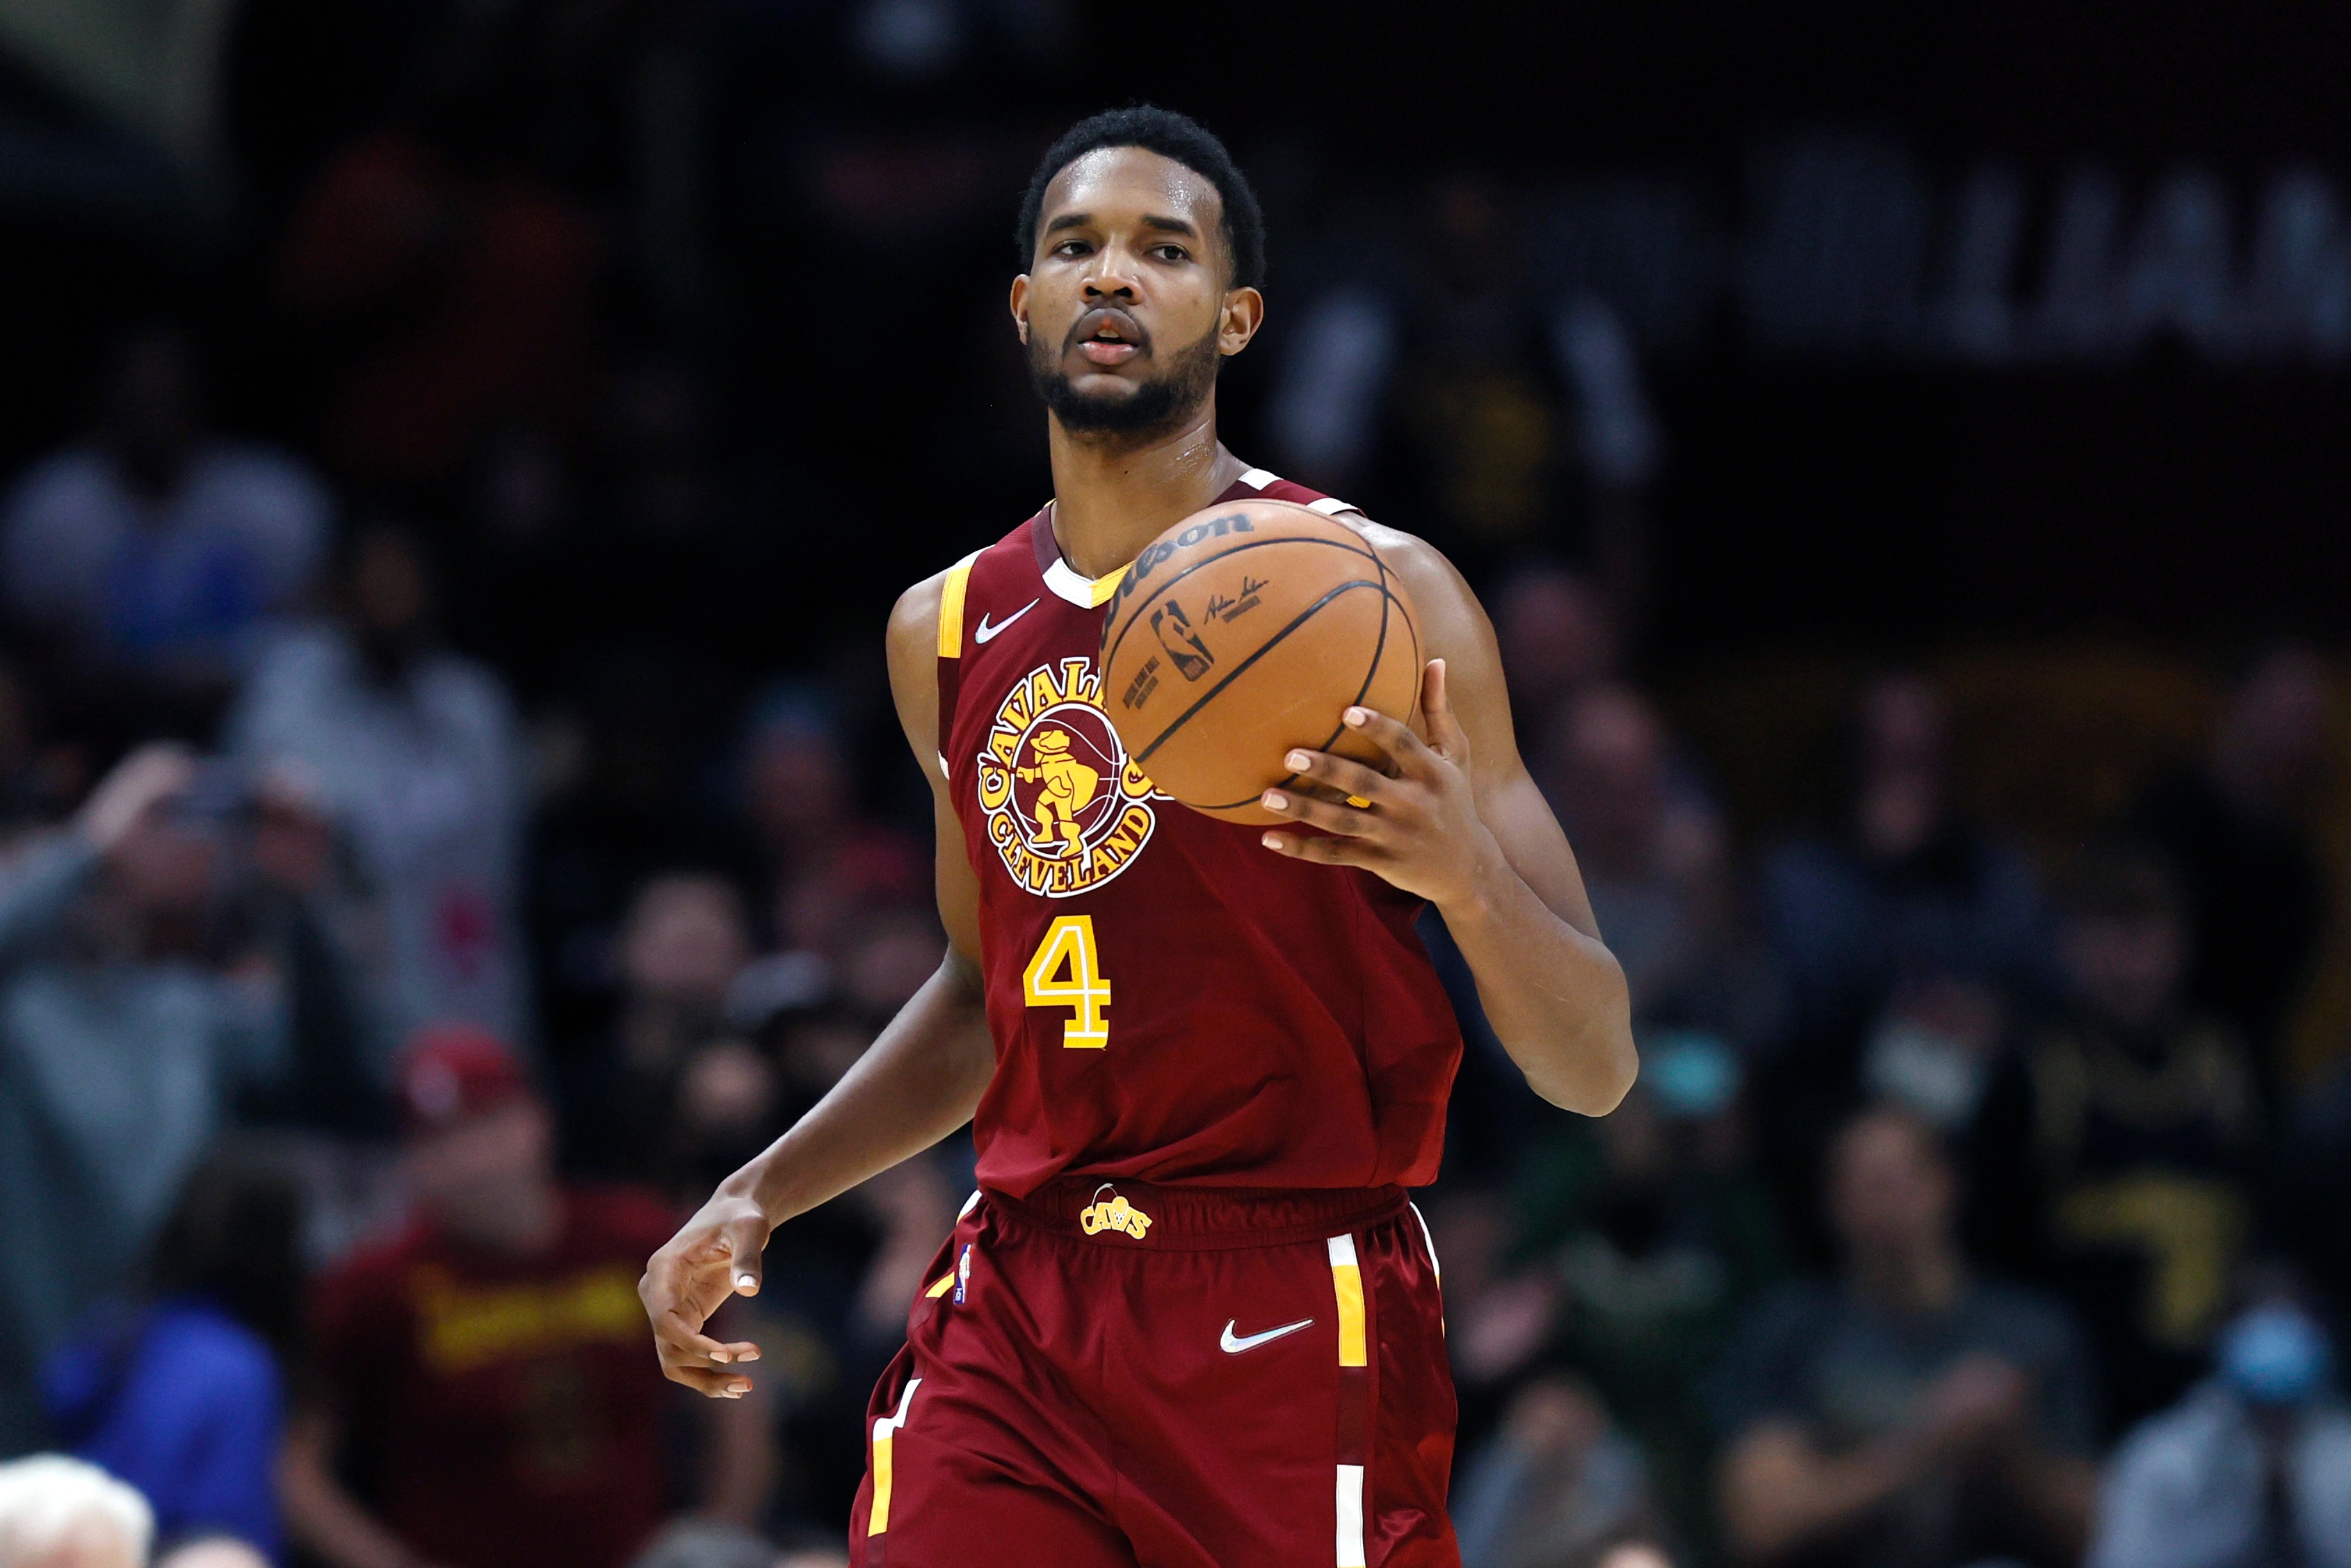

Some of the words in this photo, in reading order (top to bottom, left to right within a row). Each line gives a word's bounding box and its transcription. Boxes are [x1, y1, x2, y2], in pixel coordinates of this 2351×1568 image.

[989, 804, 1154, 896] CLEVELAND
[1023, 915, 1111, 1049] 4
[1080, 1195, 1153, 1239] CAVS
